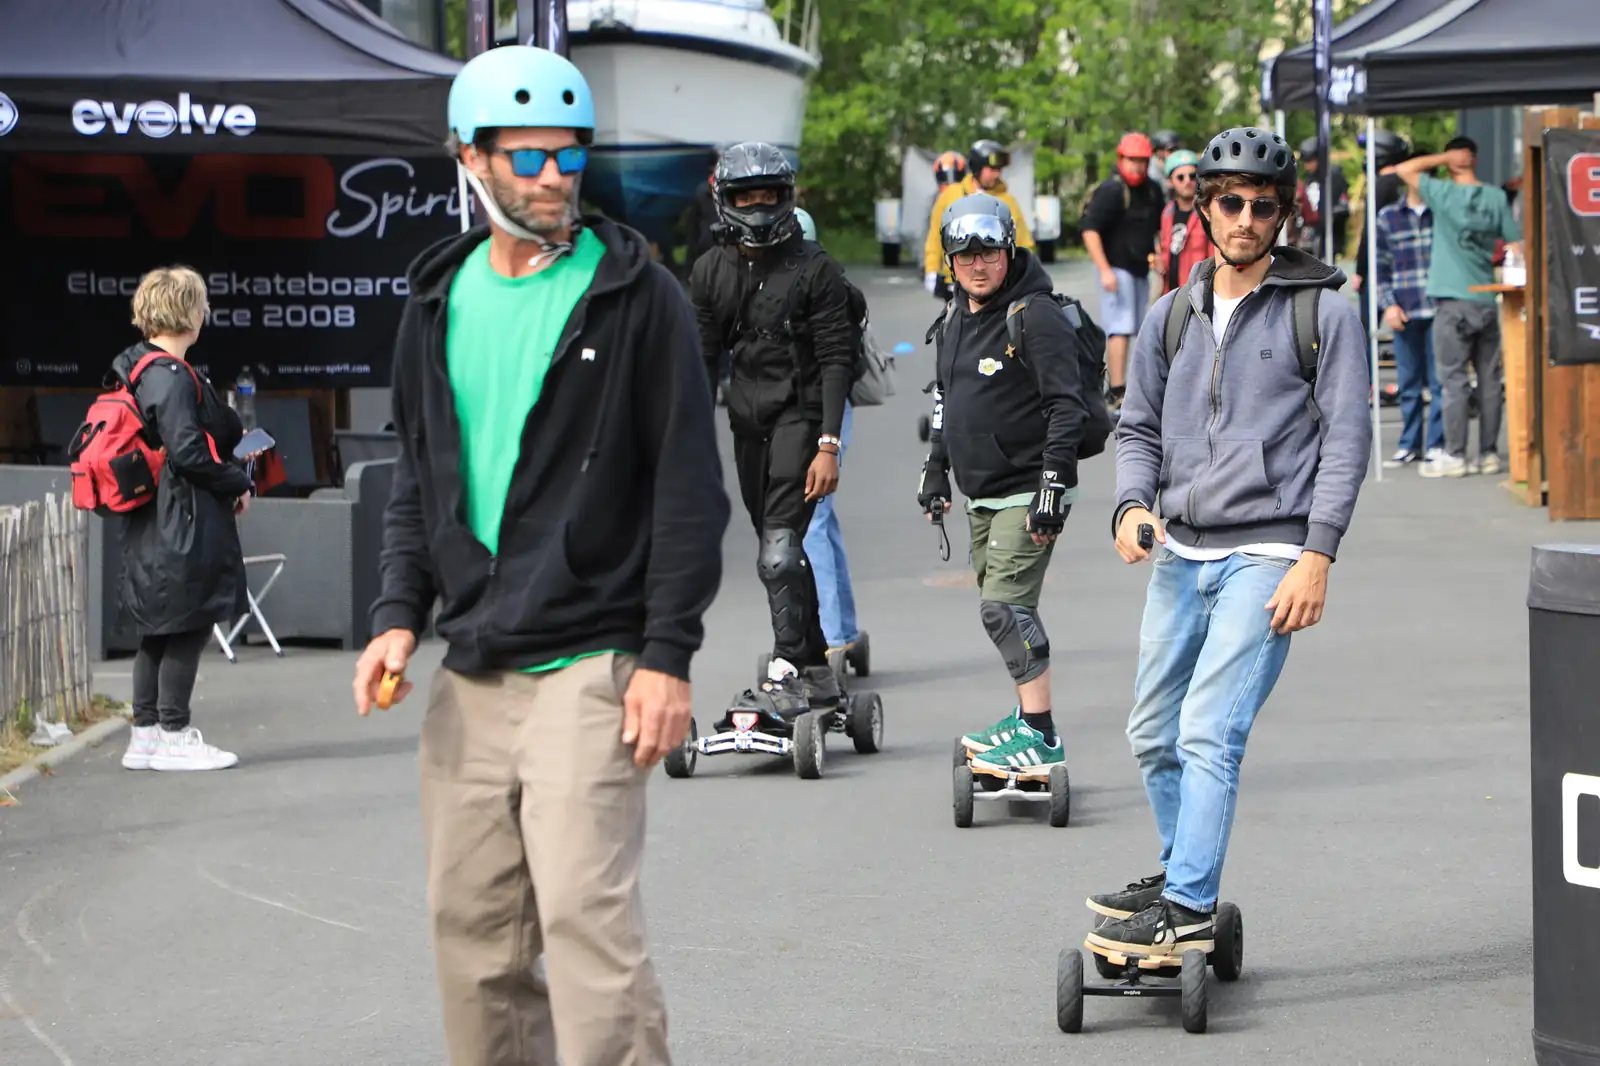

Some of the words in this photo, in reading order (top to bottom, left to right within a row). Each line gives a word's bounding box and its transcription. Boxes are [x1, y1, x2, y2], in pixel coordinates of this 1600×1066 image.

[72, 92, 256, 138] evolve
[11, 153, 335, 238] EVO
[326, 158, 475, 239] Spiri
[68, 271, 142, 295] Elec
[262, 304, 356, 328] 2008
